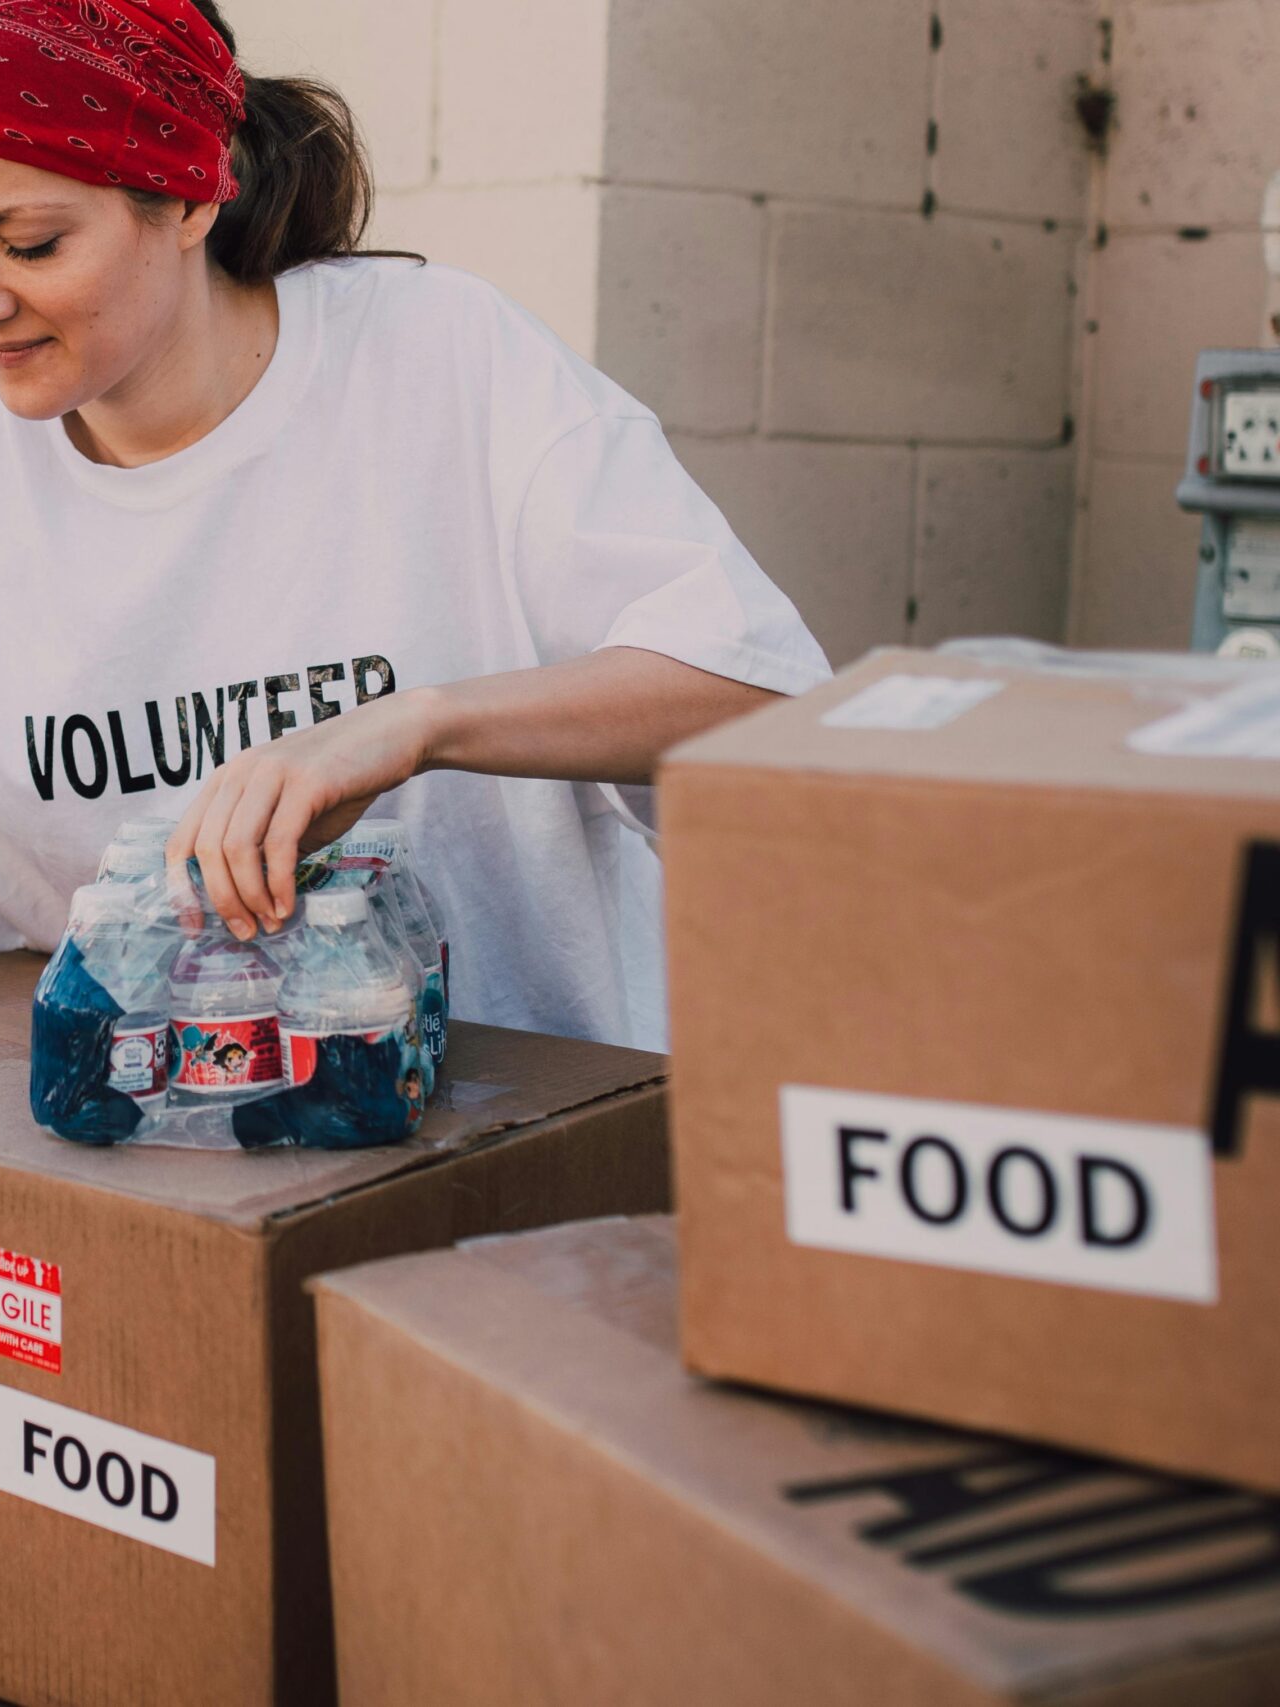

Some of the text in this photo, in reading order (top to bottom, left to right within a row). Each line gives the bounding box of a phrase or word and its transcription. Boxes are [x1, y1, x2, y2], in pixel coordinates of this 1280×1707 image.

[835, 1124, 1153, 1249] FOOD
[20, 1338, 44, 1356] CARE
[23, 1419, 179, 1523] FOOD
